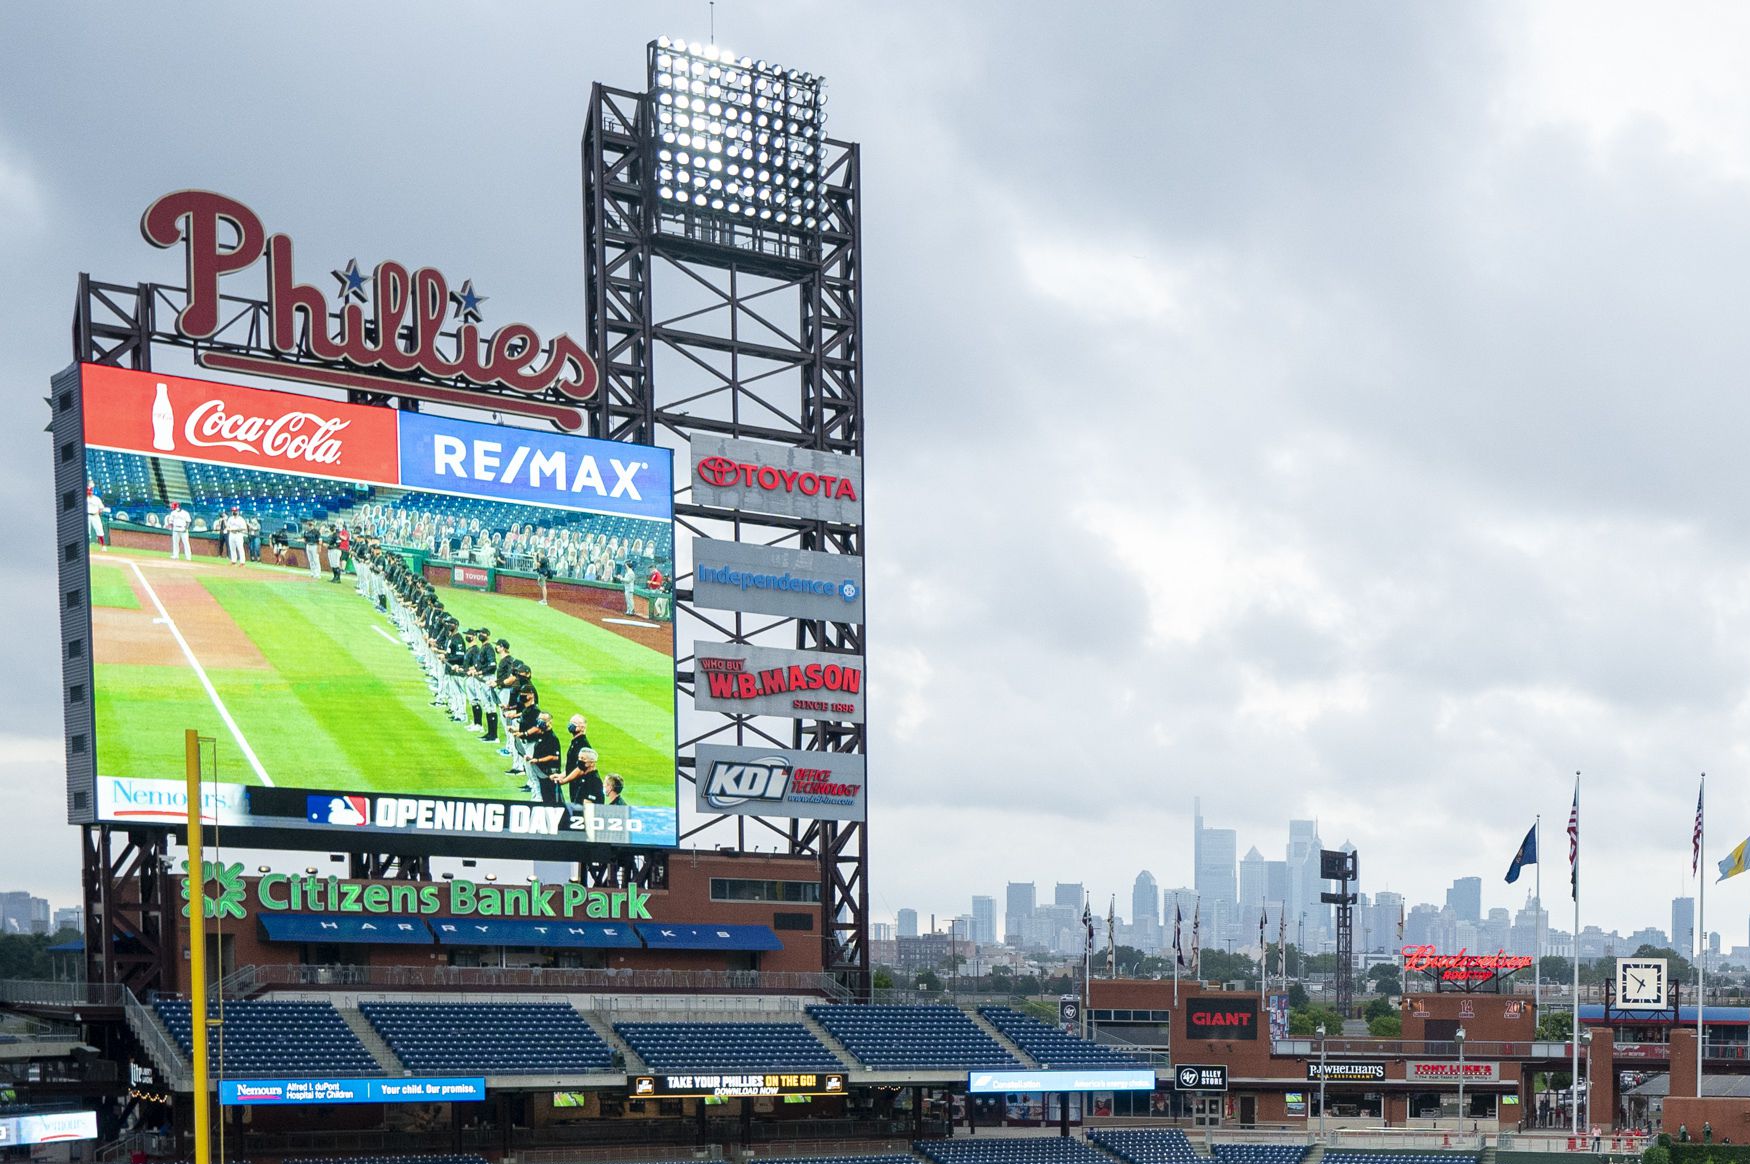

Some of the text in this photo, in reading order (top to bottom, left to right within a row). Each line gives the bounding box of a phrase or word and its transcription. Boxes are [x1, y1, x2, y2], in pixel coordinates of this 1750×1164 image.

[140, 188, 599, 401] Phillies
[184, 399, 352, 465] Coca-Cola
[433, 434, 643, 500] RE/MAX
[739, 464, 857, 501] TOYOTA
[698, 563, 836, 597] Independence
[701, 658, 745, 671] WHO BUT
[793, 700, 855, 713] SINCE 1898
[794, 768, 832, 782] OFFICE
[791, 781, 861, 797] TECHNOLOGY
[376, 797, 643, 835] OPENING DAY 2020
[258, 873, 653, 920] Citizens Bank Park
[321, 921, 489, 934] HARRY
[534, 926, 618, 936] THE
[1192, 1012, 1251, 1026] GIANT
[1201, 1070, 1221, 1078] ALLEY
[1415, 1064, 1447, 1072] TONY
[237, 1084, 282, 1095] Nemours
[287, 1082, 307, 1091] Alfred
[667, 1076, 692, 1089] TAKE
[694, 1076, 720, 1088] YOUR
[722, 1075, 764, 1088] PHILLIES
[765, 1075, 779, 1087] ON
[780, 1075, 798, 1087] THE
[800, 1075, 816, 1087] GO!
[286, 1090, 354, 1099] Hospital for Children
[381, 1084, 476, 1095] Your child. Our promise.
[714, 1086, 779, 1096] DOWNLOAD NOW
